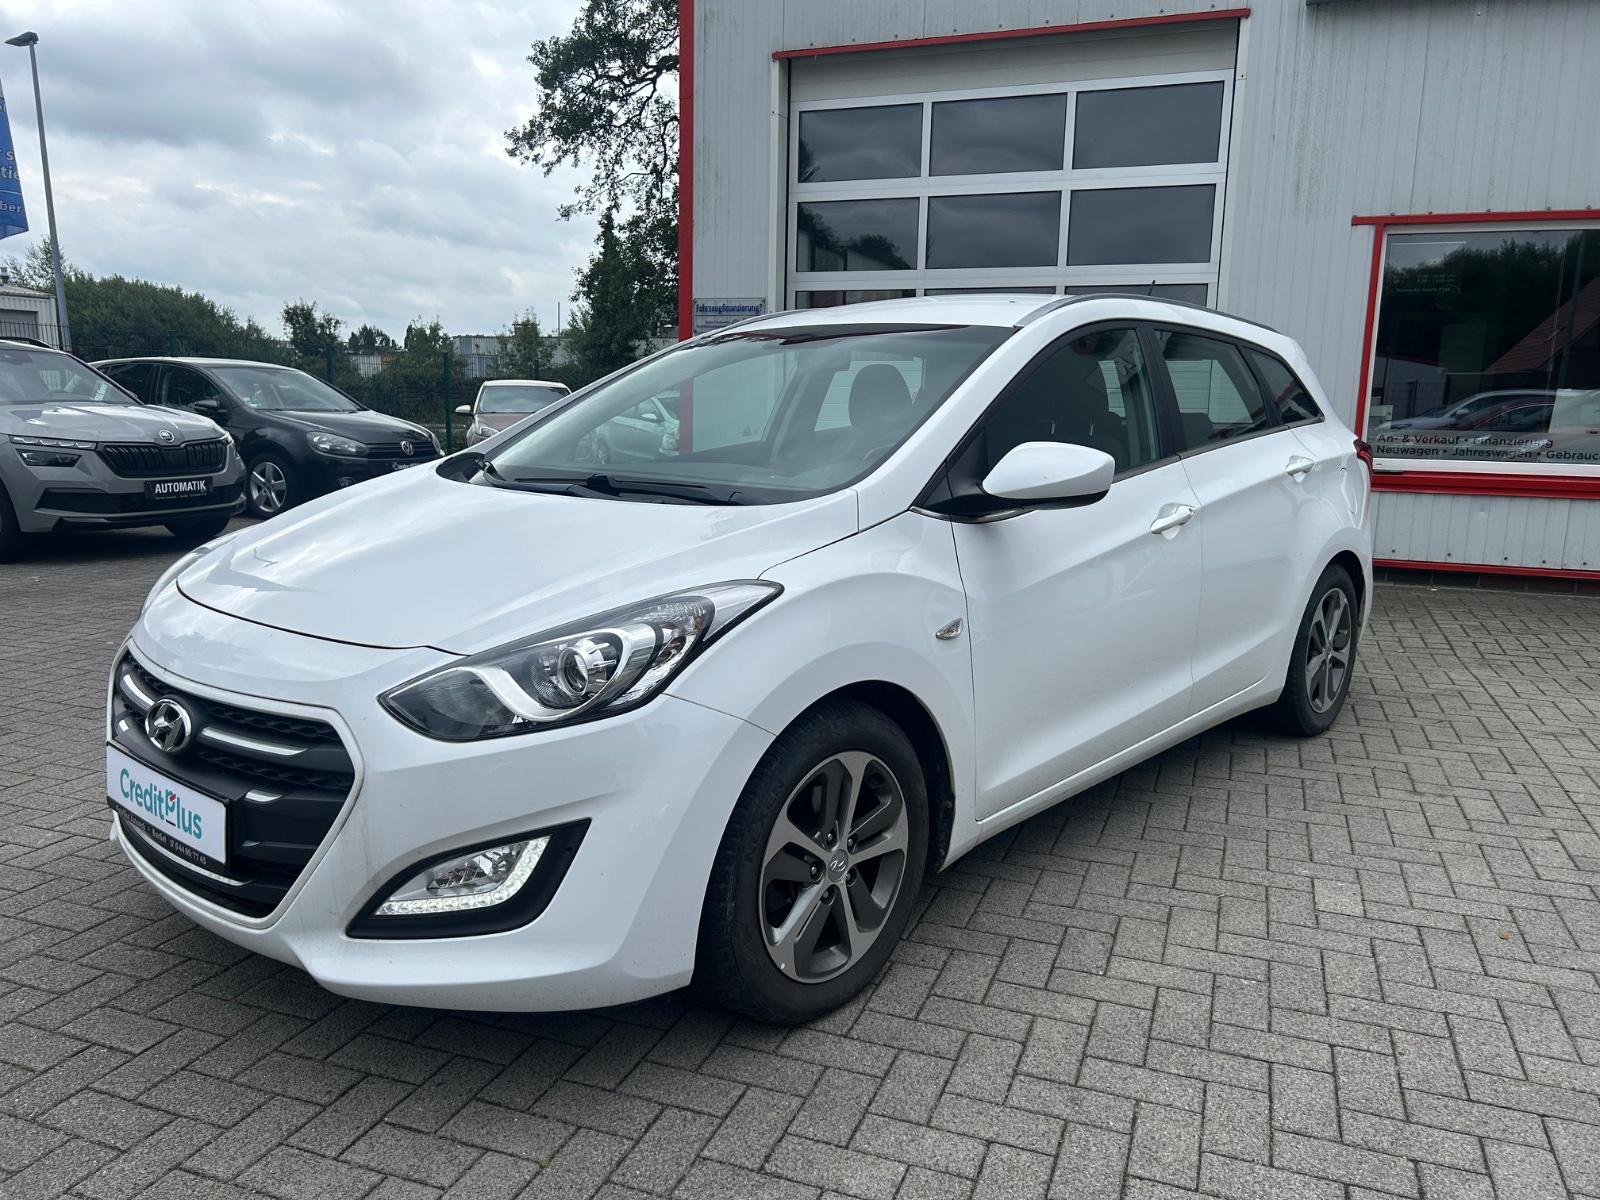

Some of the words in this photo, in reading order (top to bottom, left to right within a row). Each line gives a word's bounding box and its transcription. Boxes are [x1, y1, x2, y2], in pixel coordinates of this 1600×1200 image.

[696, 303, 763, 314] Fahrzeugfinanzierung?
[1377, 434, 1398, 443] An-
[1402, 434, 1410, 443] &
[1415, 434, 1460, 445] Verkauf
[1376, 445, 1439, 457] Neuwagen
[1452, 447, 1532, 460] Jahreswagen
[155, 480, 206, 494] AUTOMATIK
[119, 767, 203, 840] CreditPlus
